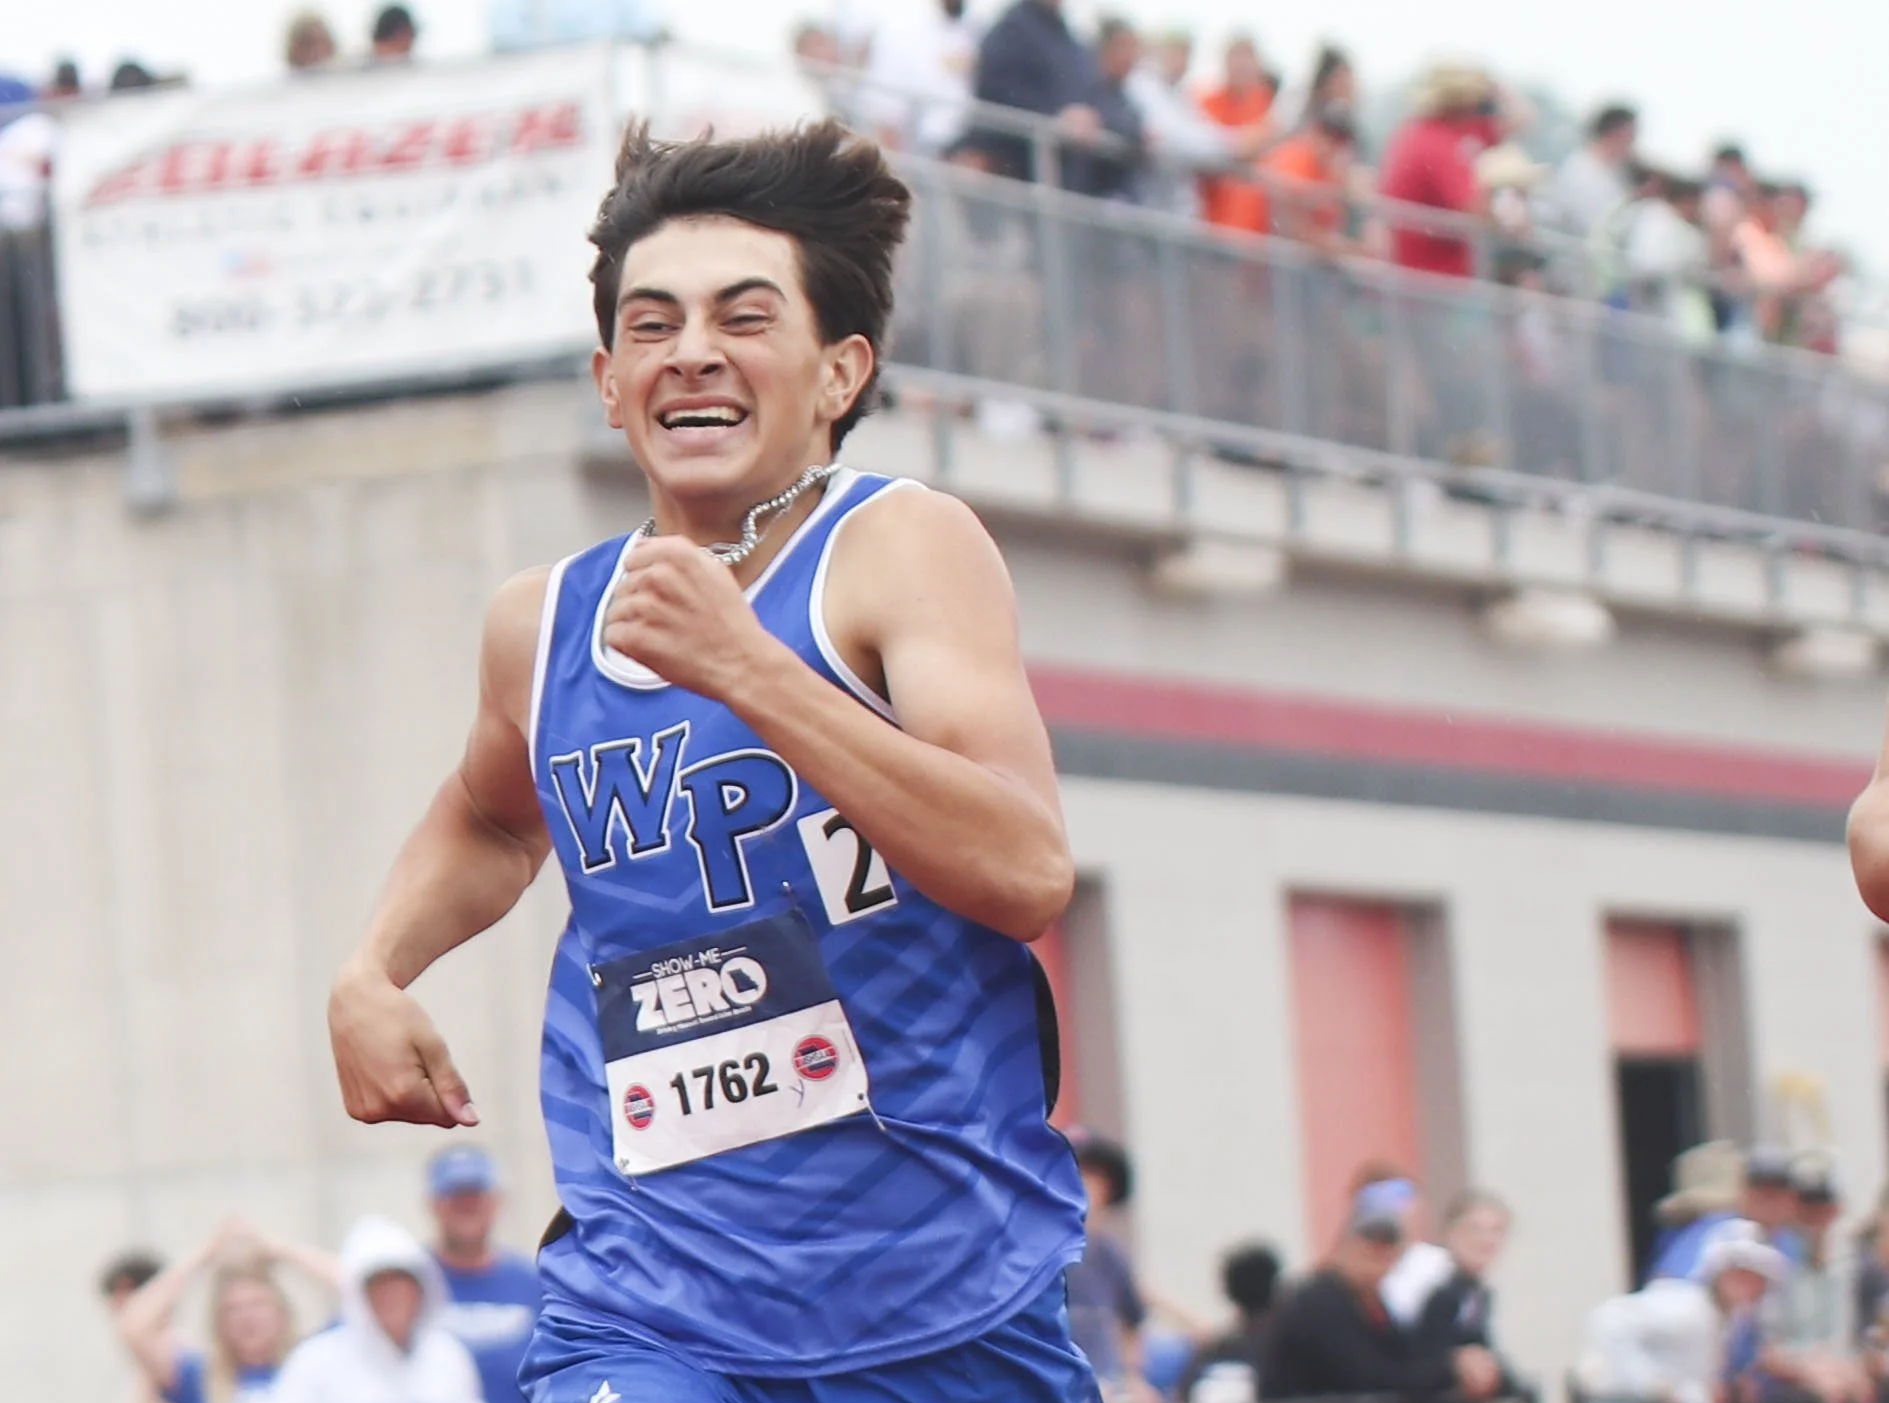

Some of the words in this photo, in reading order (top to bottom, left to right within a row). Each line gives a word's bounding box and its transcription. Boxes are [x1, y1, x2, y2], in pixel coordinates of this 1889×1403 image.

[550, 720, 798, 913] WP
[822, 814, 895, 914] 2
[630, 956, 767, 1031] ZERO
[651, 947, 721, 978] SHOW-ME
[669, 1051, 779, 1116] 1762
